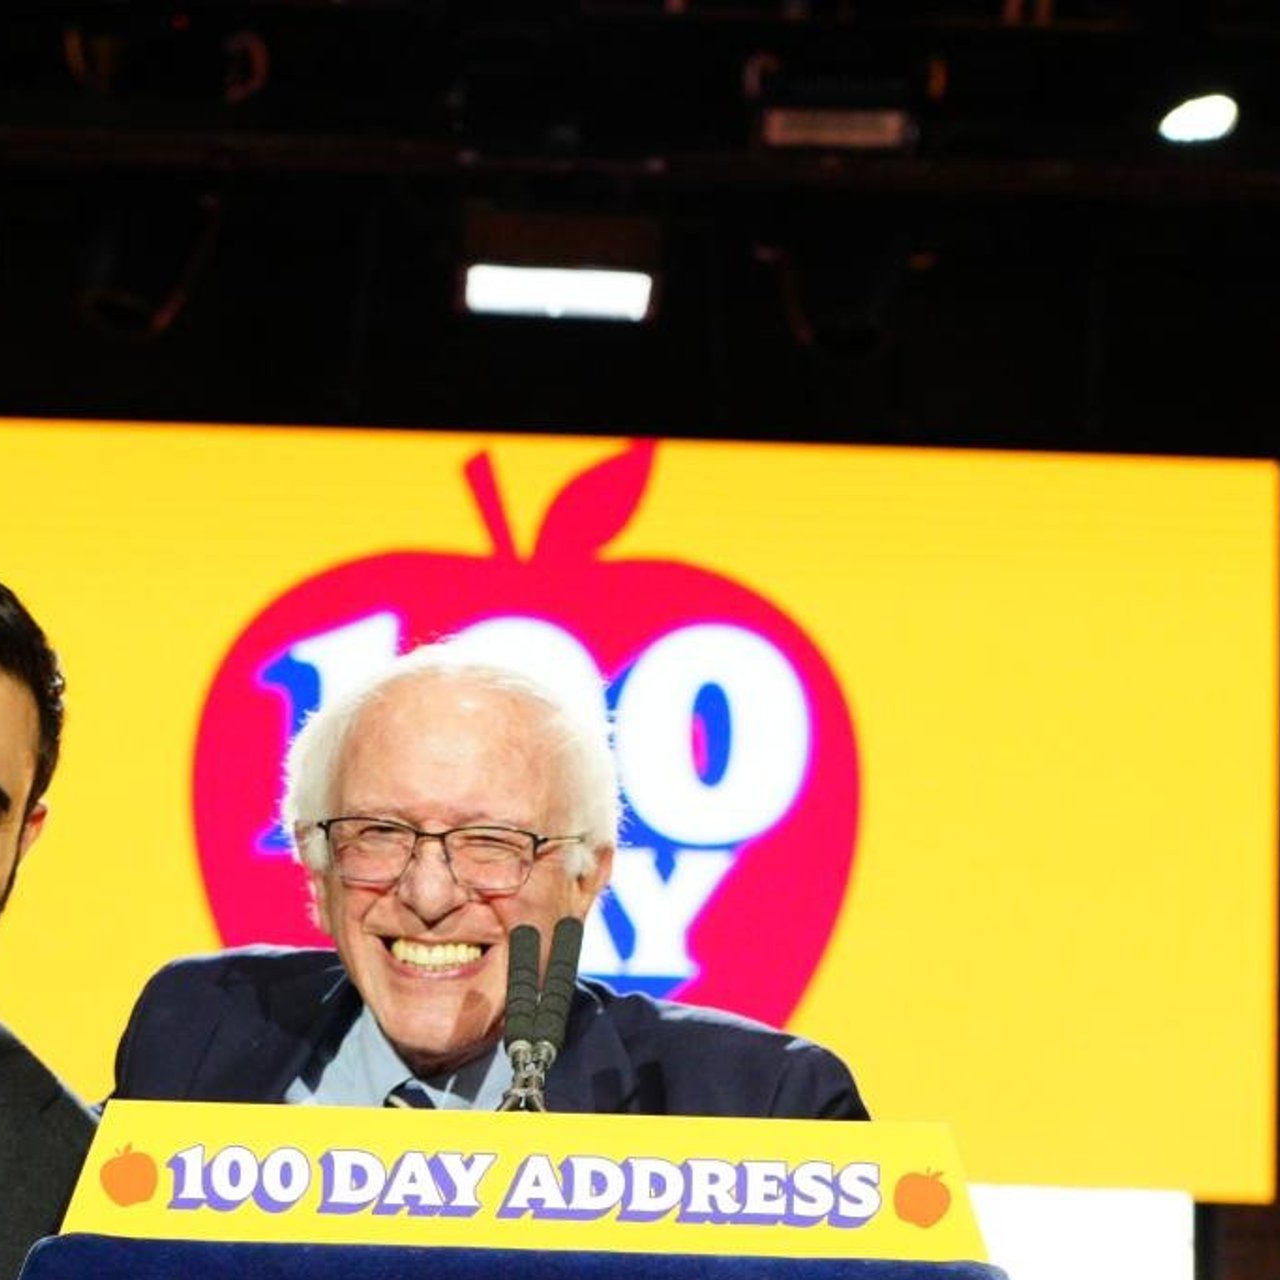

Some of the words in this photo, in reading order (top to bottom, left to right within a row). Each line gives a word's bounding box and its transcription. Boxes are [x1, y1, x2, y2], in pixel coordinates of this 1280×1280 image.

[167, 1143, 312, 1213] 100
[317, 1148, 498, 1218] DAY
[496, 1153, 882, 1229] ADDRESS
